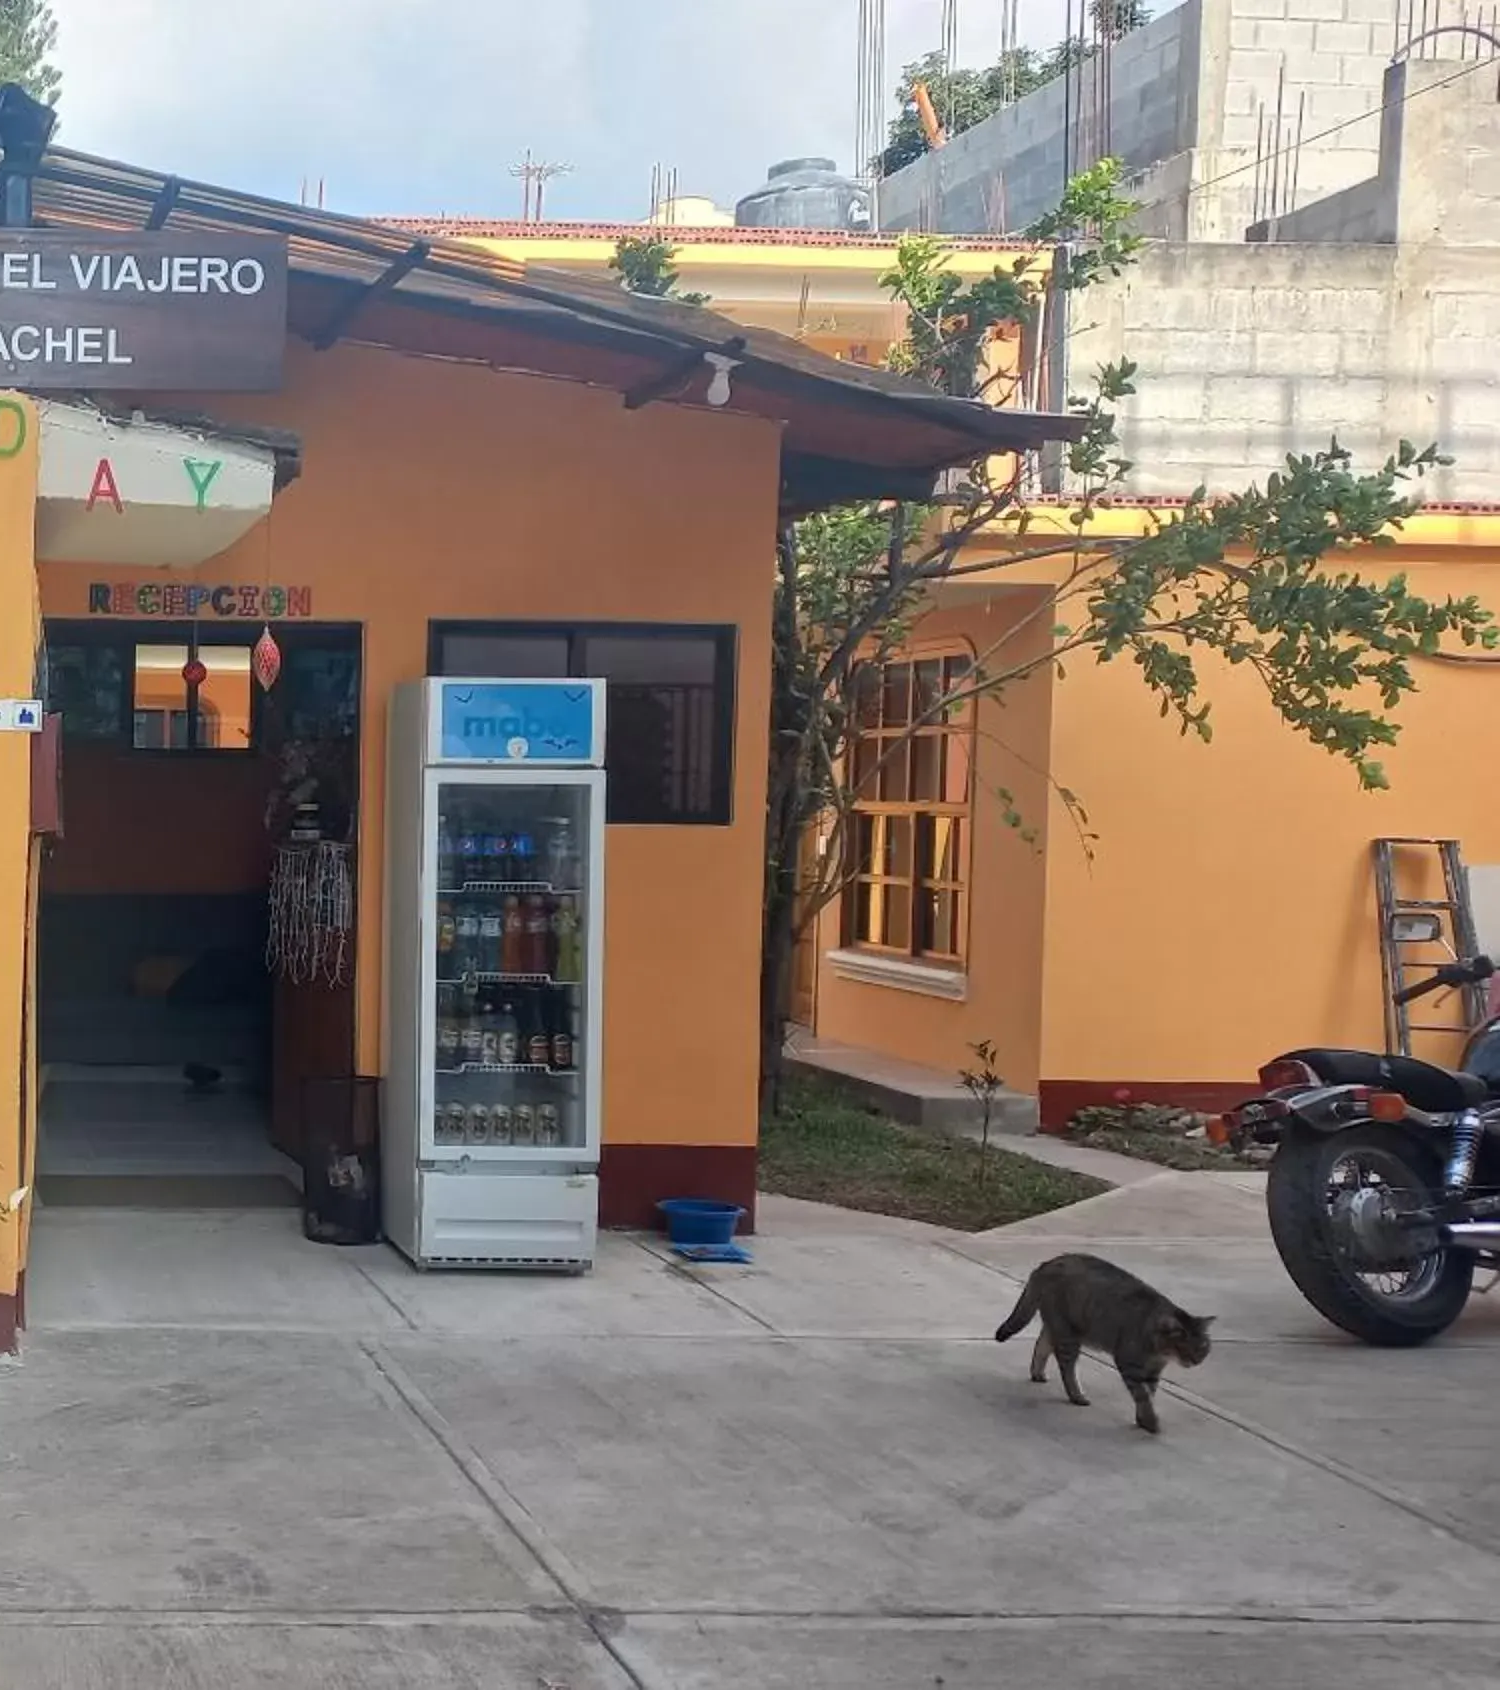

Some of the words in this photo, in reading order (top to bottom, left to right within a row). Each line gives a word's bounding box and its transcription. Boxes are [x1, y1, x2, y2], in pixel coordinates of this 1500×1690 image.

[2, 257, 56, 290] EL
[70, 255, 264, 295] VIAJERO
[89, 583, 311, 616] RECEPCION
